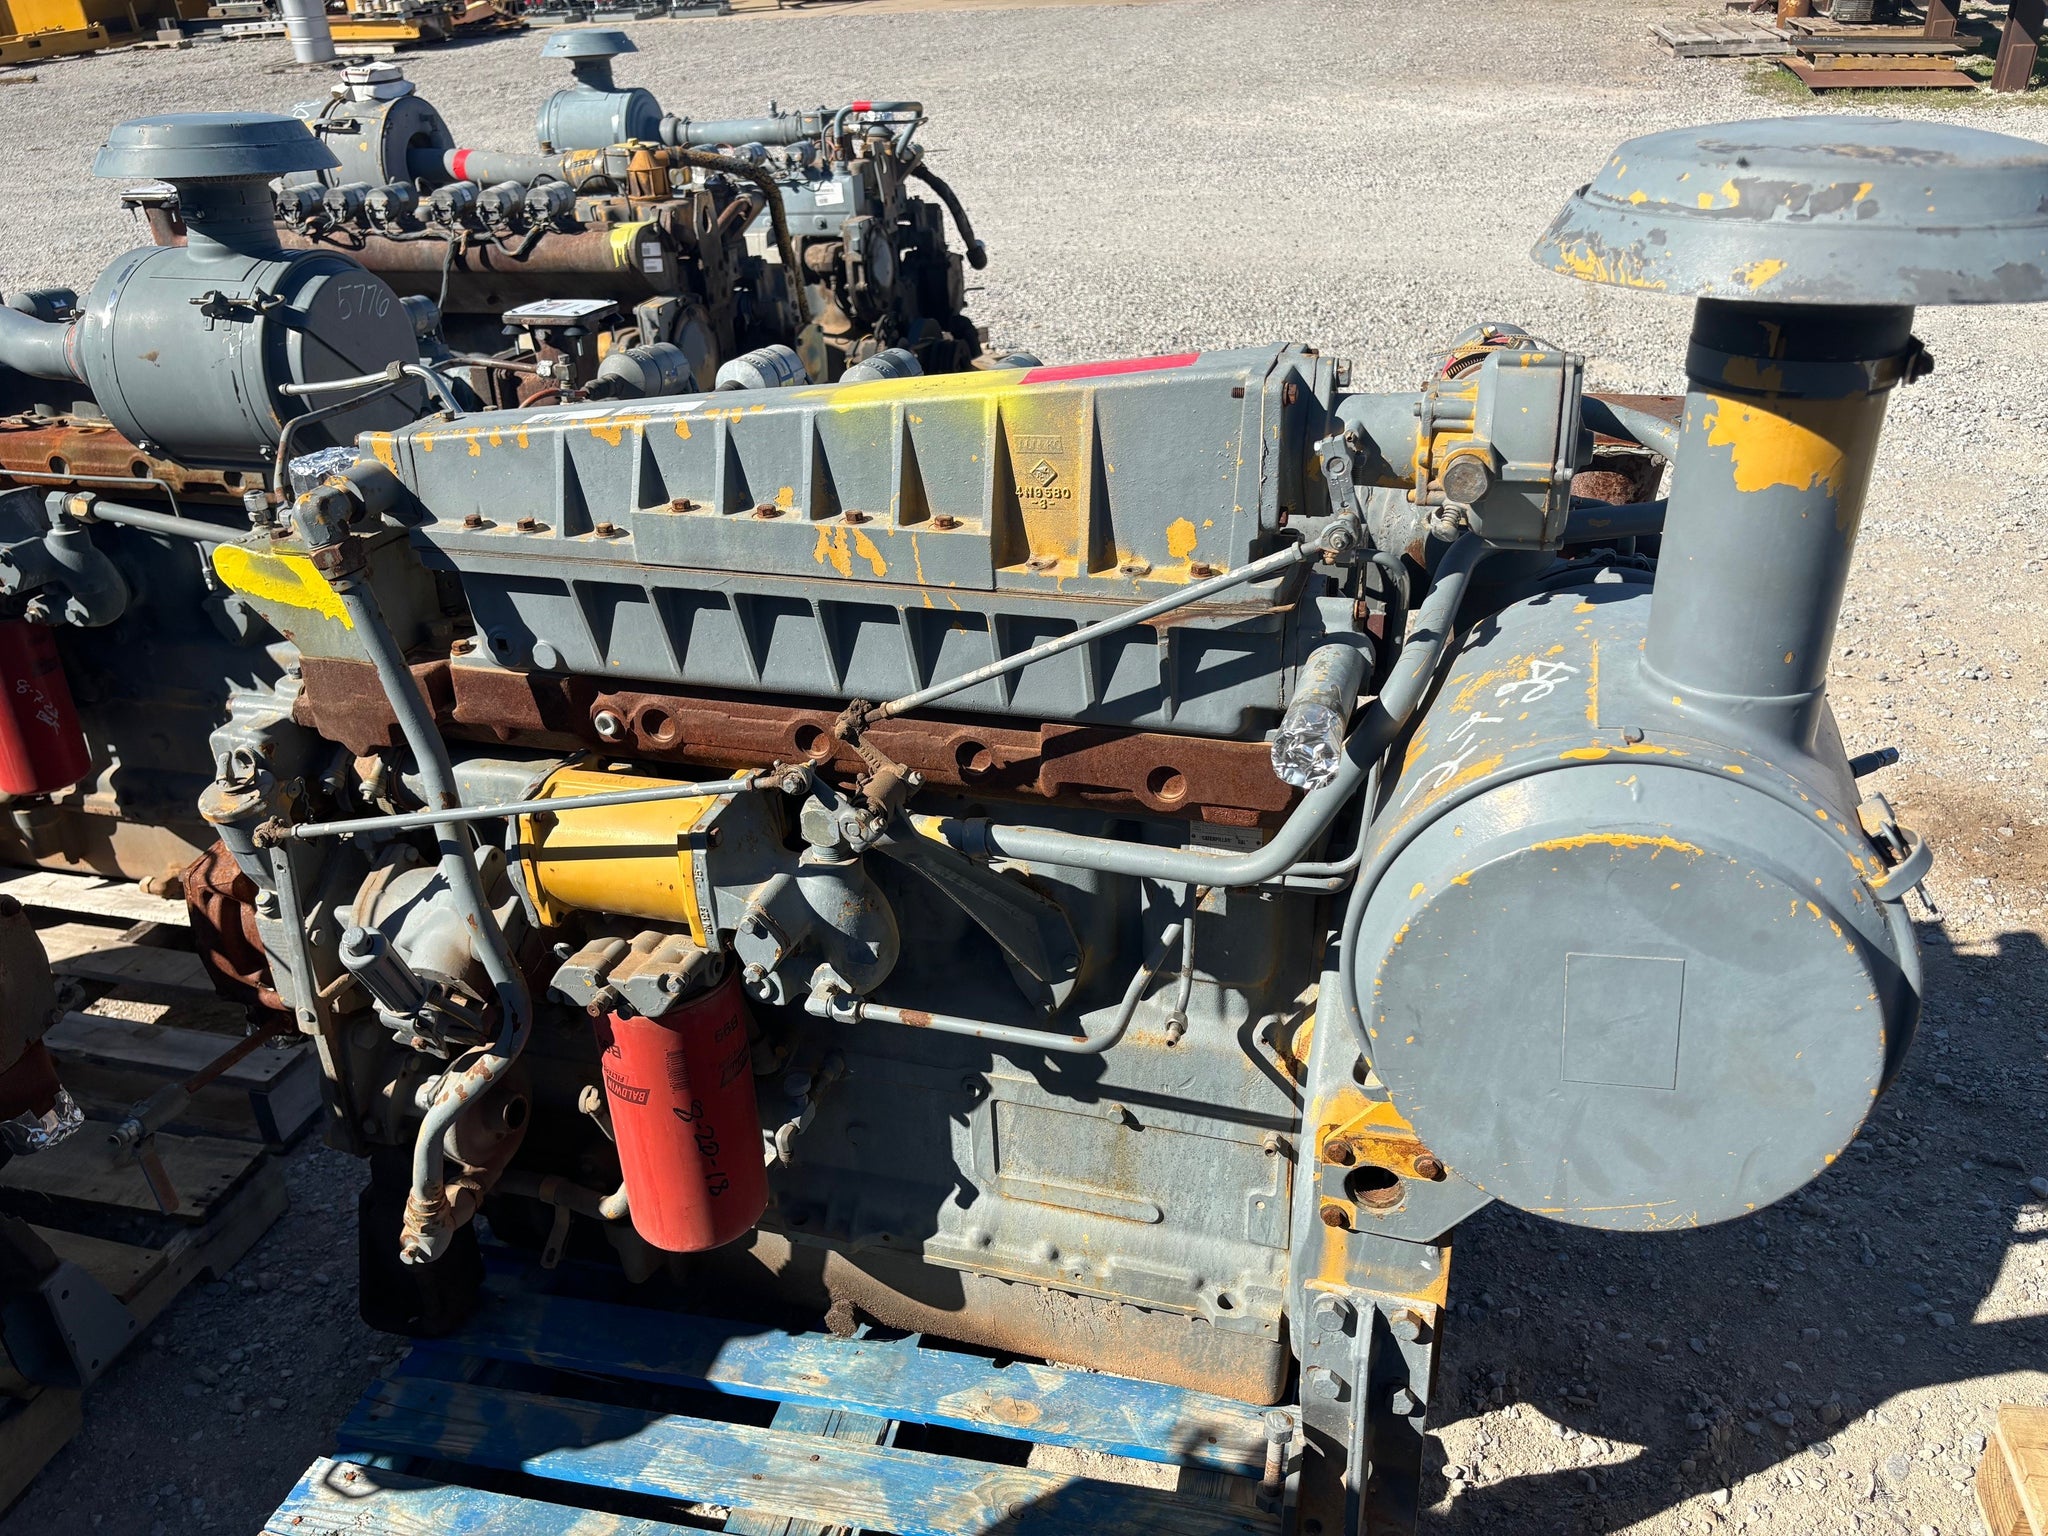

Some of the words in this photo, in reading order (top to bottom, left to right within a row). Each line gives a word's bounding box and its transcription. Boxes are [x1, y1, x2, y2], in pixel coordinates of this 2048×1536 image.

[337, 283, 391, 321] 5776
[607, 1077, 647, 1103] BALDWIN
[672, 1099, 730, 1198] 8-20-18
